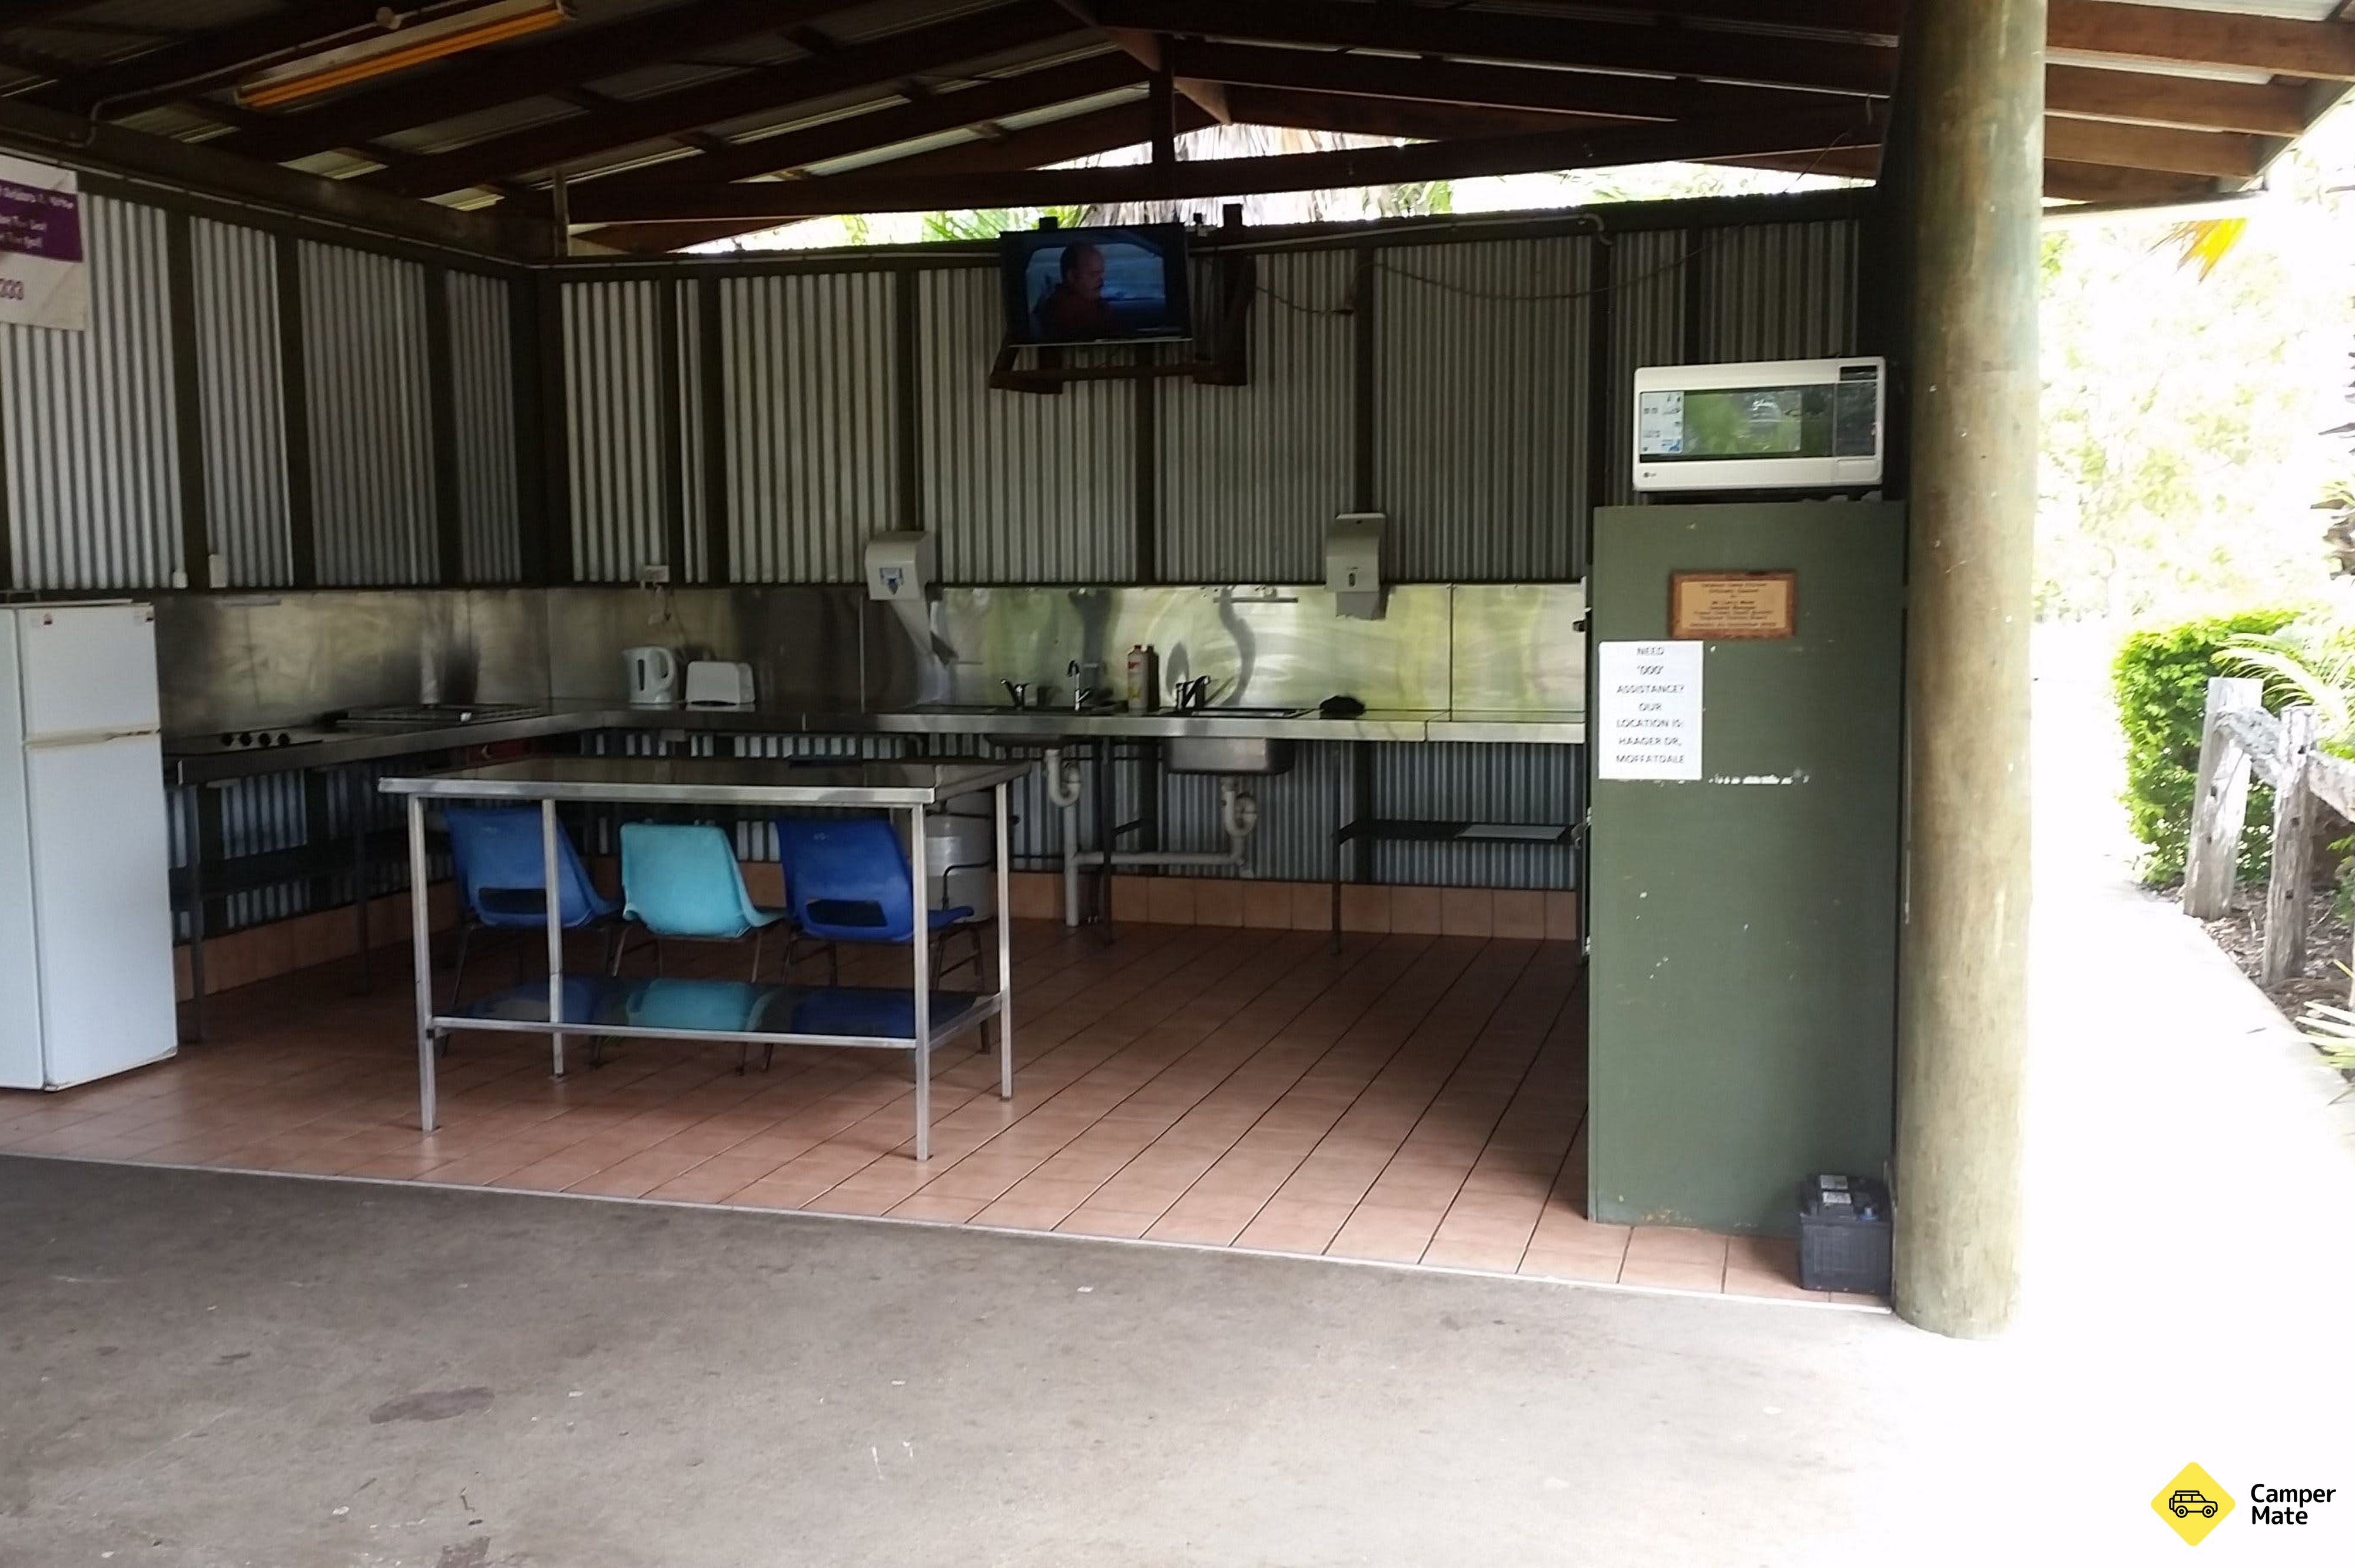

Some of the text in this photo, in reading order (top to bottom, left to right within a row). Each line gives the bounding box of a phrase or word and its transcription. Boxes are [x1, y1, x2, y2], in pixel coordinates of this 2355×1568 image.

[1637, 647, 1664, 656] NEED
[1617, 685, 1684, 693] ASSISTANCE?
[1638, 703, 1662, 712] OUR
[1616, 719, 1669, 727] LOCATION
[1616, 755, 1684, 763] MOFFATDALE
